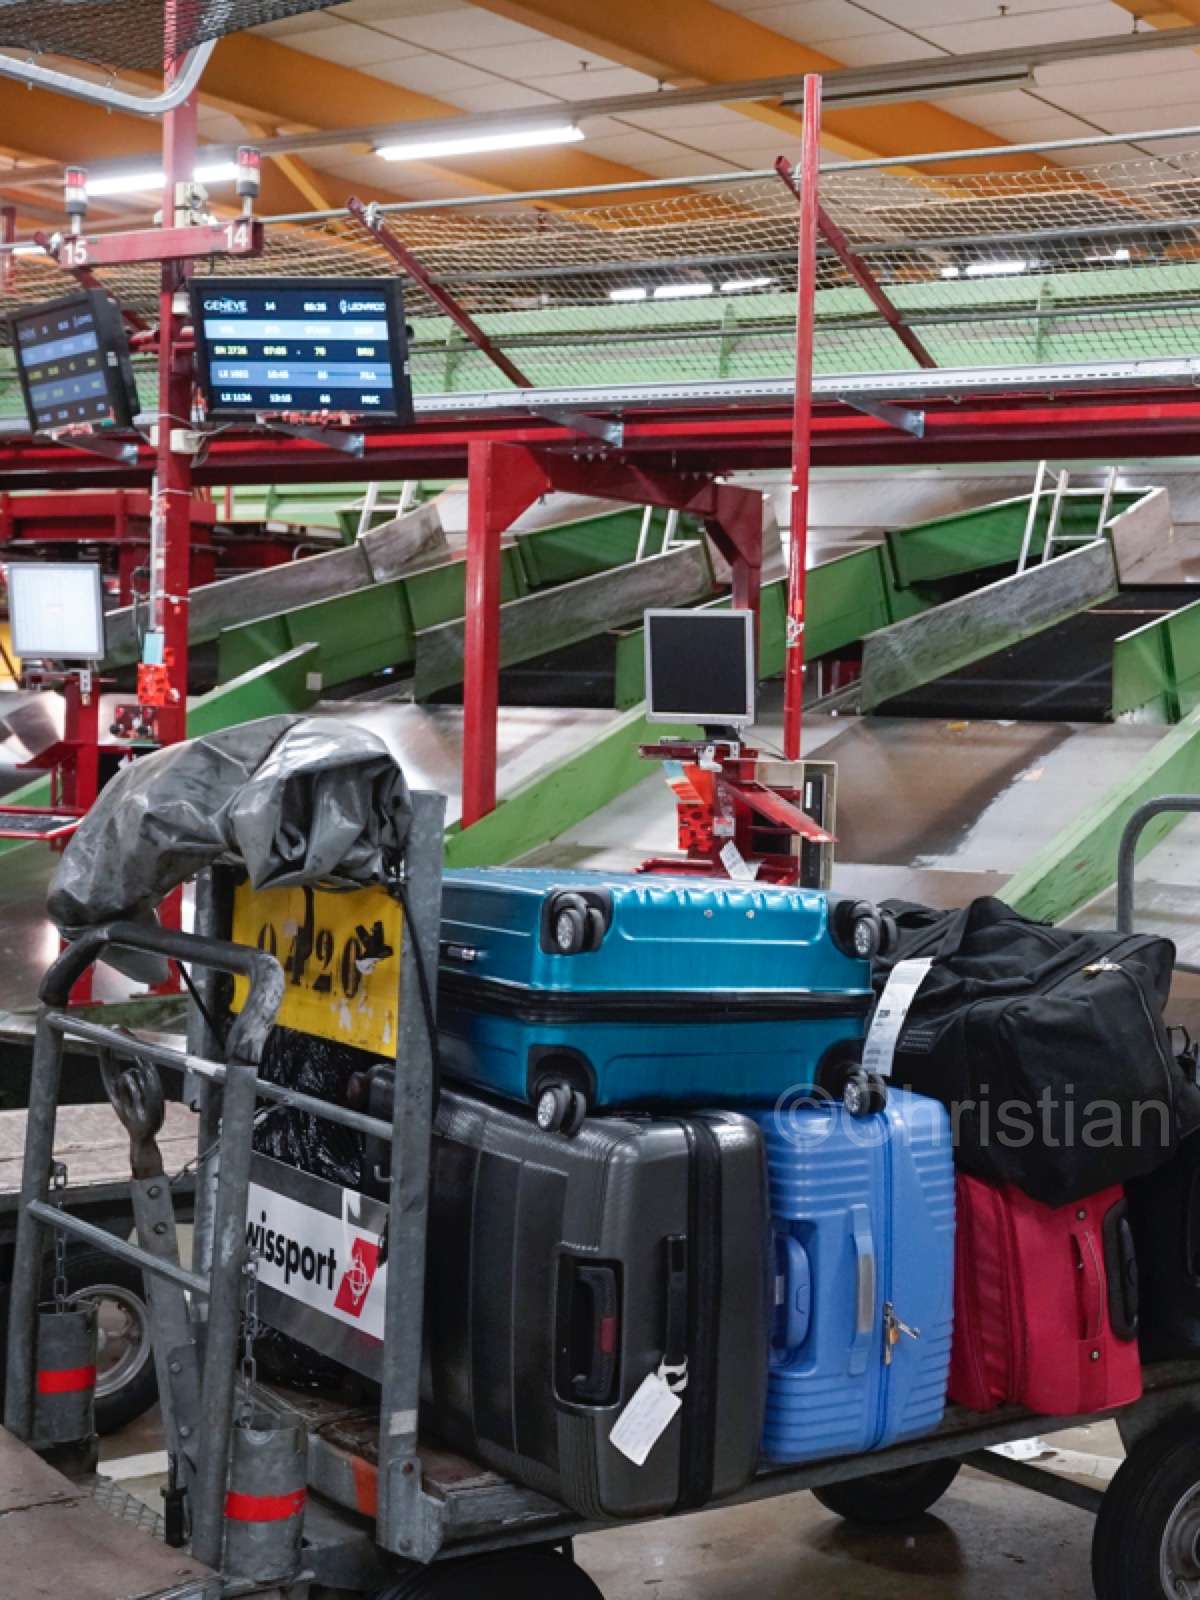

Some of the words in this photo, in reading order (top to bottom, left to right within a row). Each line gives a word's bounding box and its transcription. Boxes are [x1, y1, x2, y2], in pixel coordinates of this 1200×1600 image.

[223, 222, 249, 248] 14
[63, 239, 87, 265] 15
[244, 1209, 337, 1291] wissport
